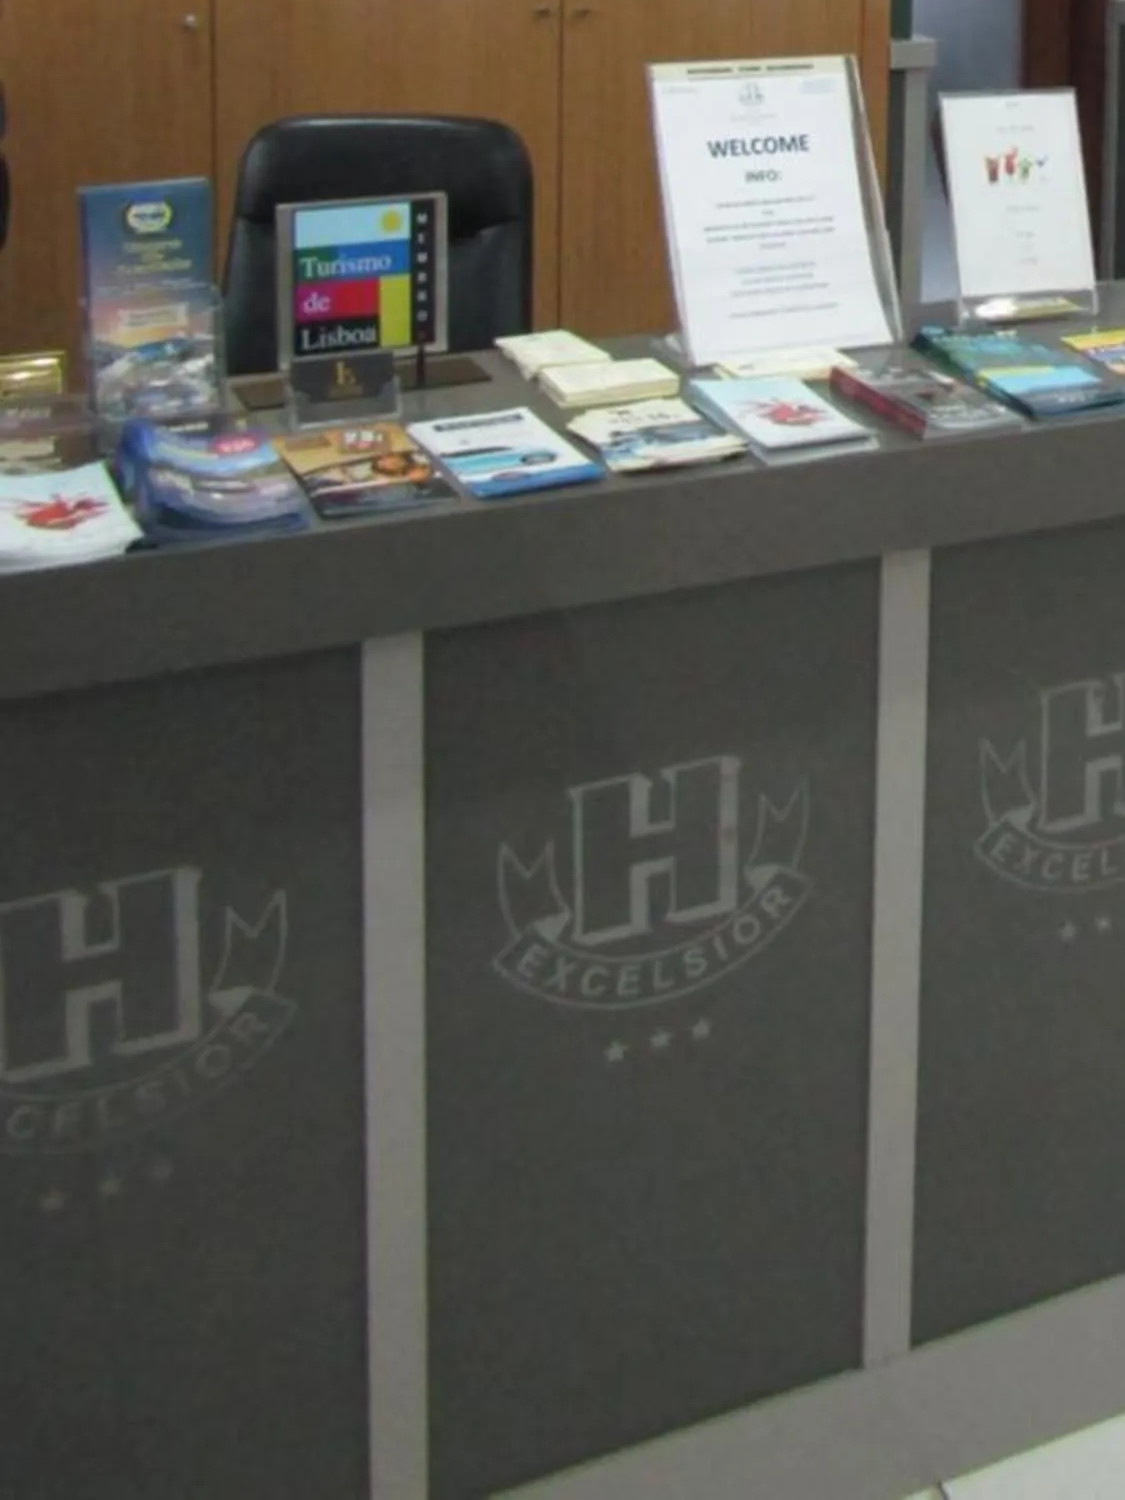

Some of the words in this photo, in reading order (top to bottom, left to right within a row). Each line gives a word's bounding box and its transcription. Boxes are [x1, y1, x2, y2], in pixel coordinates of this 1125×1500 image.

[706, 133, 810, 159] WELCOME
[744, 167, 783, 184] INFO:
[301, 252, 392, 279] Turismo
[303, 292, 331, 316] de
[302, 325, 377, 350] Lisboa
[567, 755, 743, 947] H
[516, 888, 794, 997] EXCELSIOR
